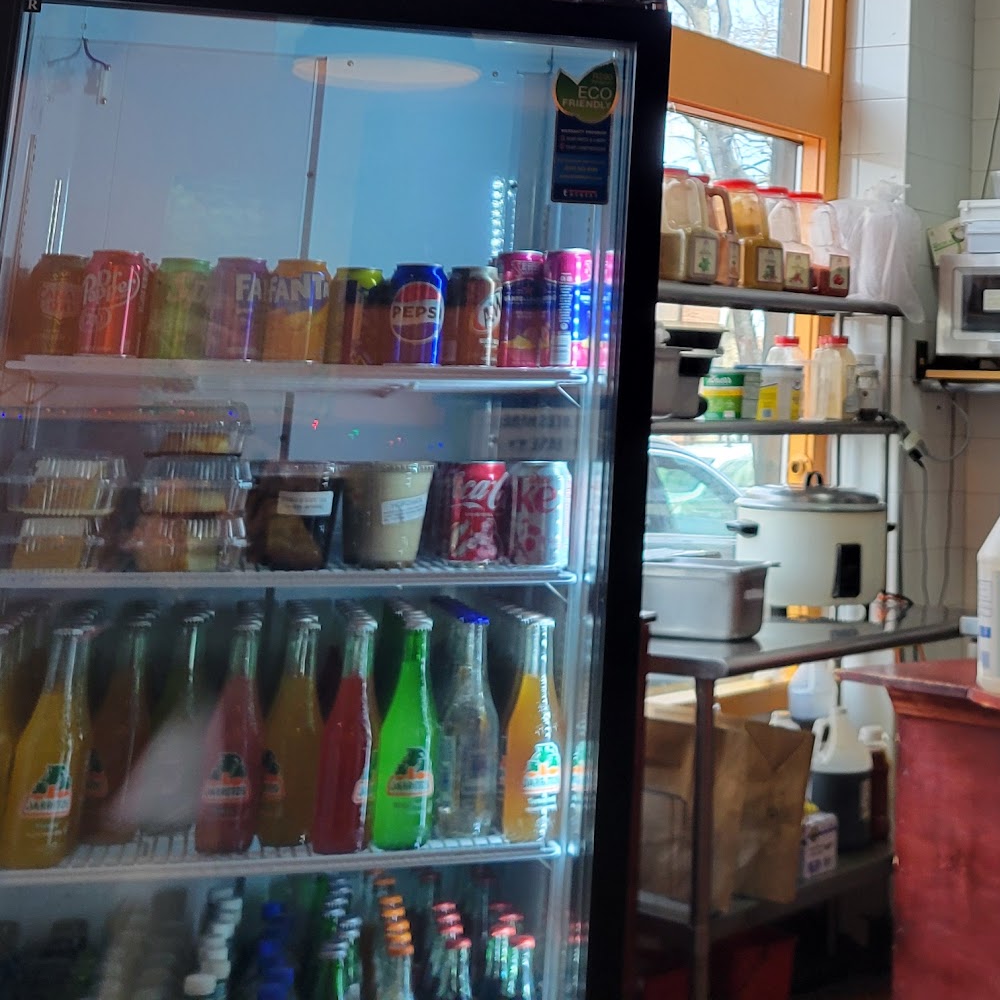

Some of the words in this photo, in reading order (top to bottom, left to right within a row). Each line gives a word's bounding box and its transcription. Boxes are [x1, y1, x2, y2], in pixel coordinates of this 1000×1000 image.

[28, 0, 38, 10] R
[577, 85, 613, 100] ECO
[561, 97, 611, 110] FRIENDLY
[392, 304, 441, 320] PEPS
